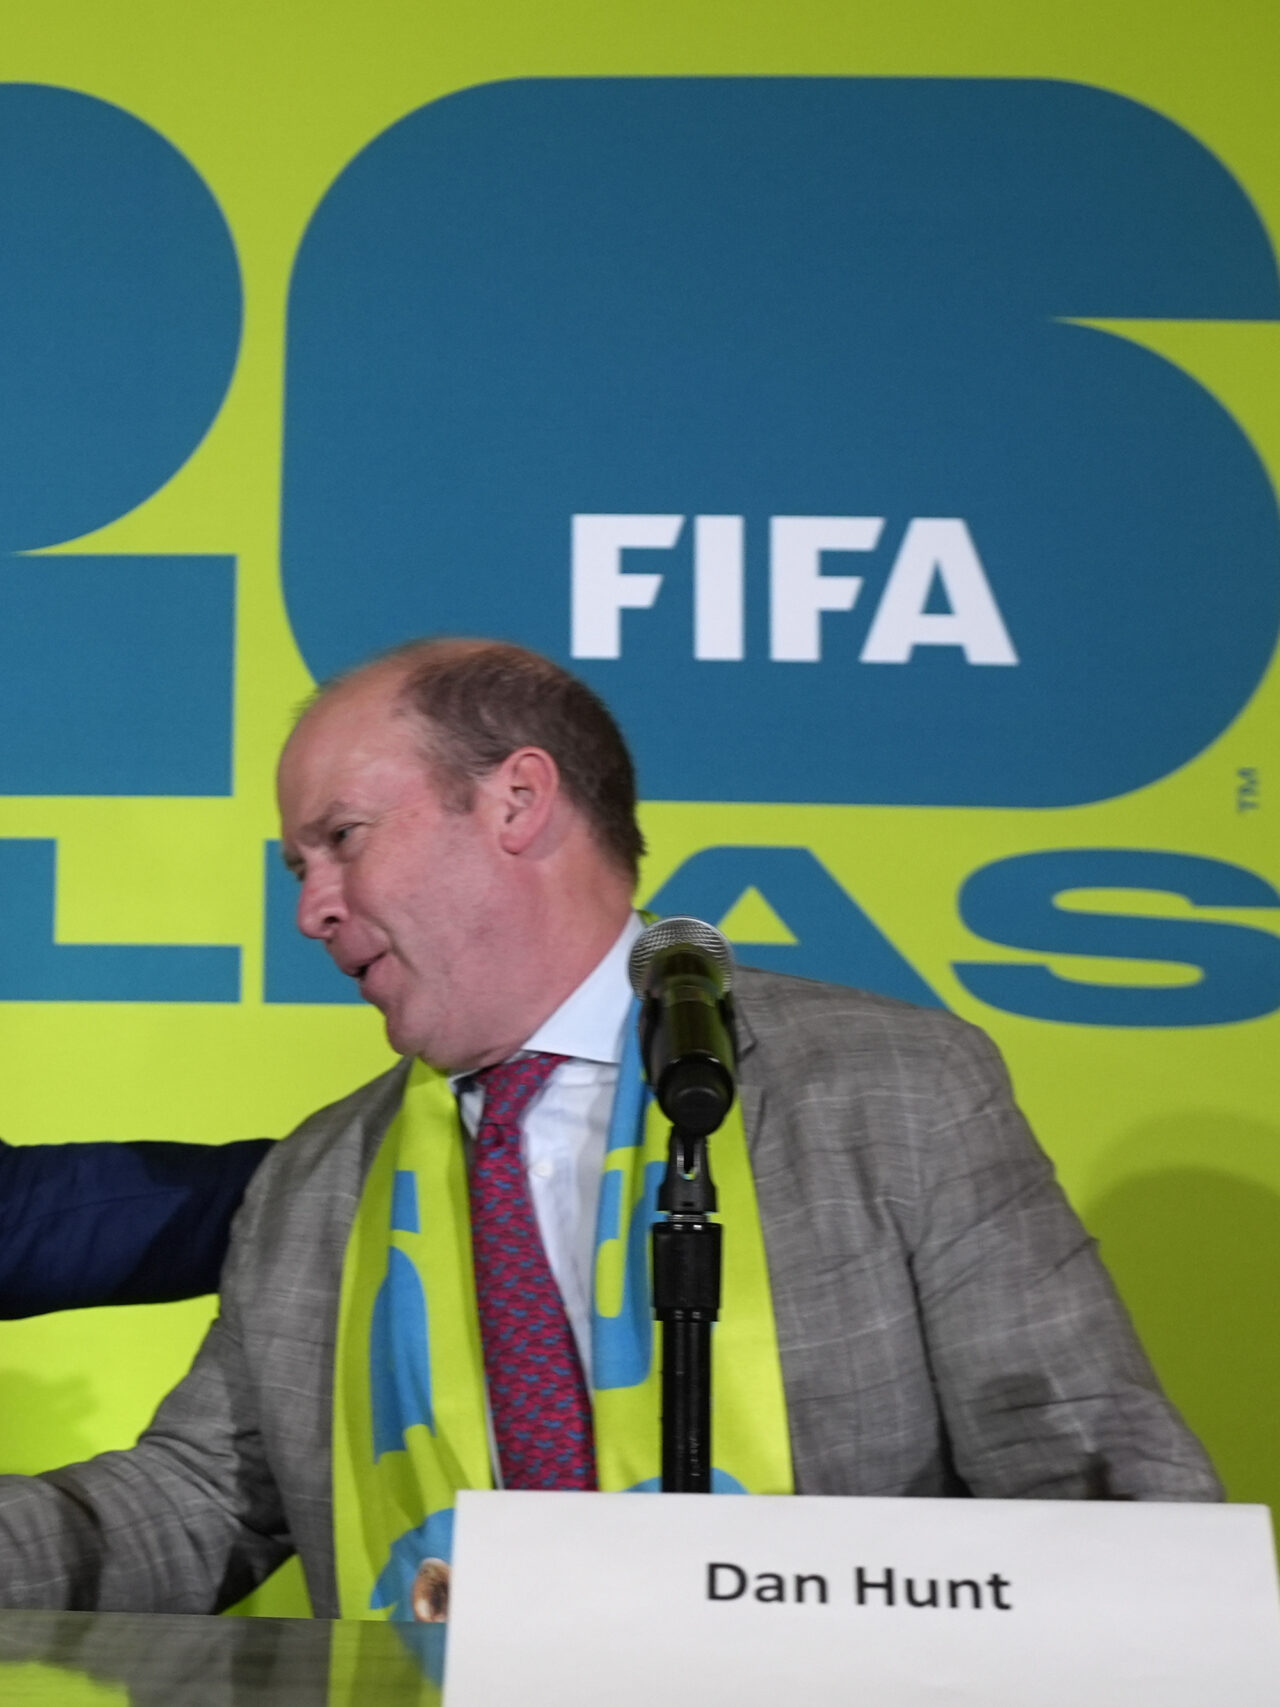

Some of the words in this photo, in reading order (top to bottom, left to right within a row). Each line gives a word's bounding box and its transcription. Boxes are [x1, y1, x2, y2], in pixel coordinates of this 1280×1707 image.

[571, 513, 1019, 667] FIFA
[706, 1561, 829, 1604] Dan
[854, 1565, 1013, 1611] Hunt
